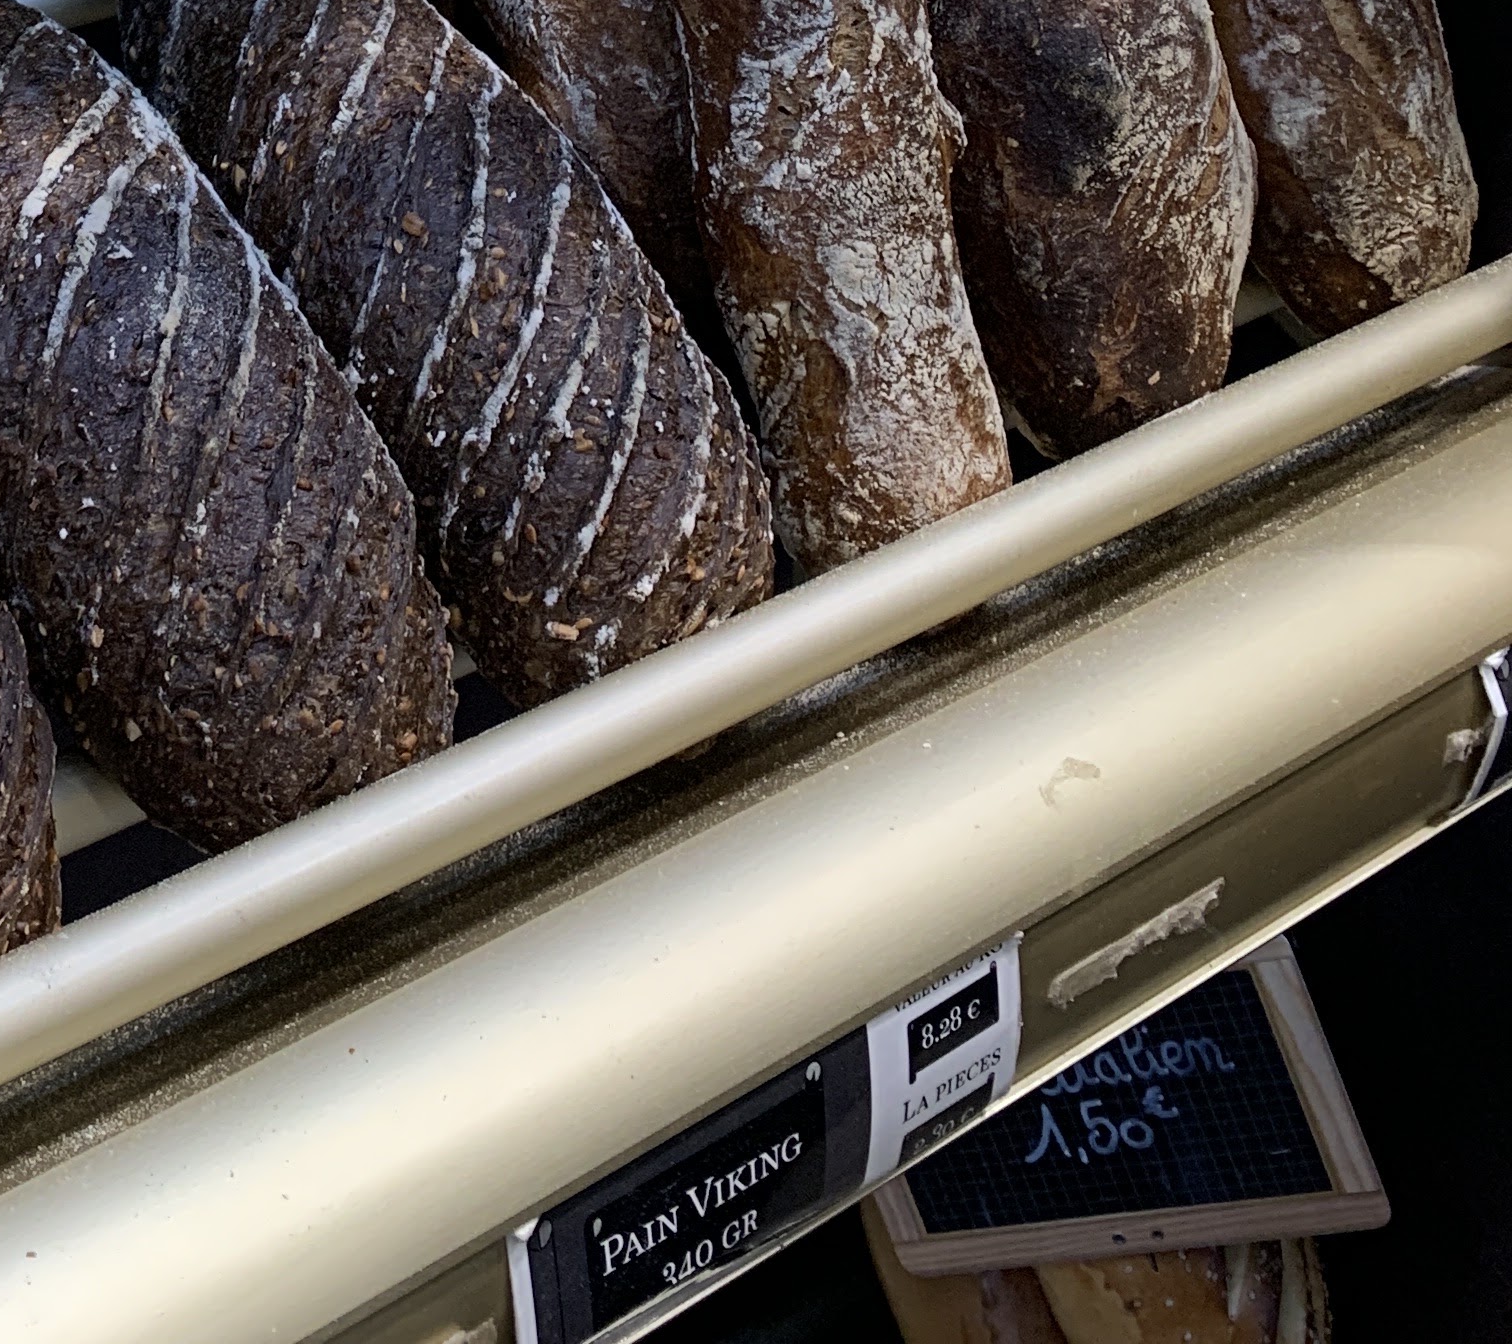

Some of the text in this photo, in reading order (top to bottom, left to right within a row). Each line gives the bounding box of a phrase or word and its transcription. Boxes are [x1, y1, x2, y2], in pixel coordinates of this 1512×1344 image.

[921, 998, 981, 1049] 8.28 €
[902, 1047, 1001, 1124] LA PIECES
[599, 1132, 803, 1277] PAIN VIKING
[662, 1209, 758, 1285] 340 GR
